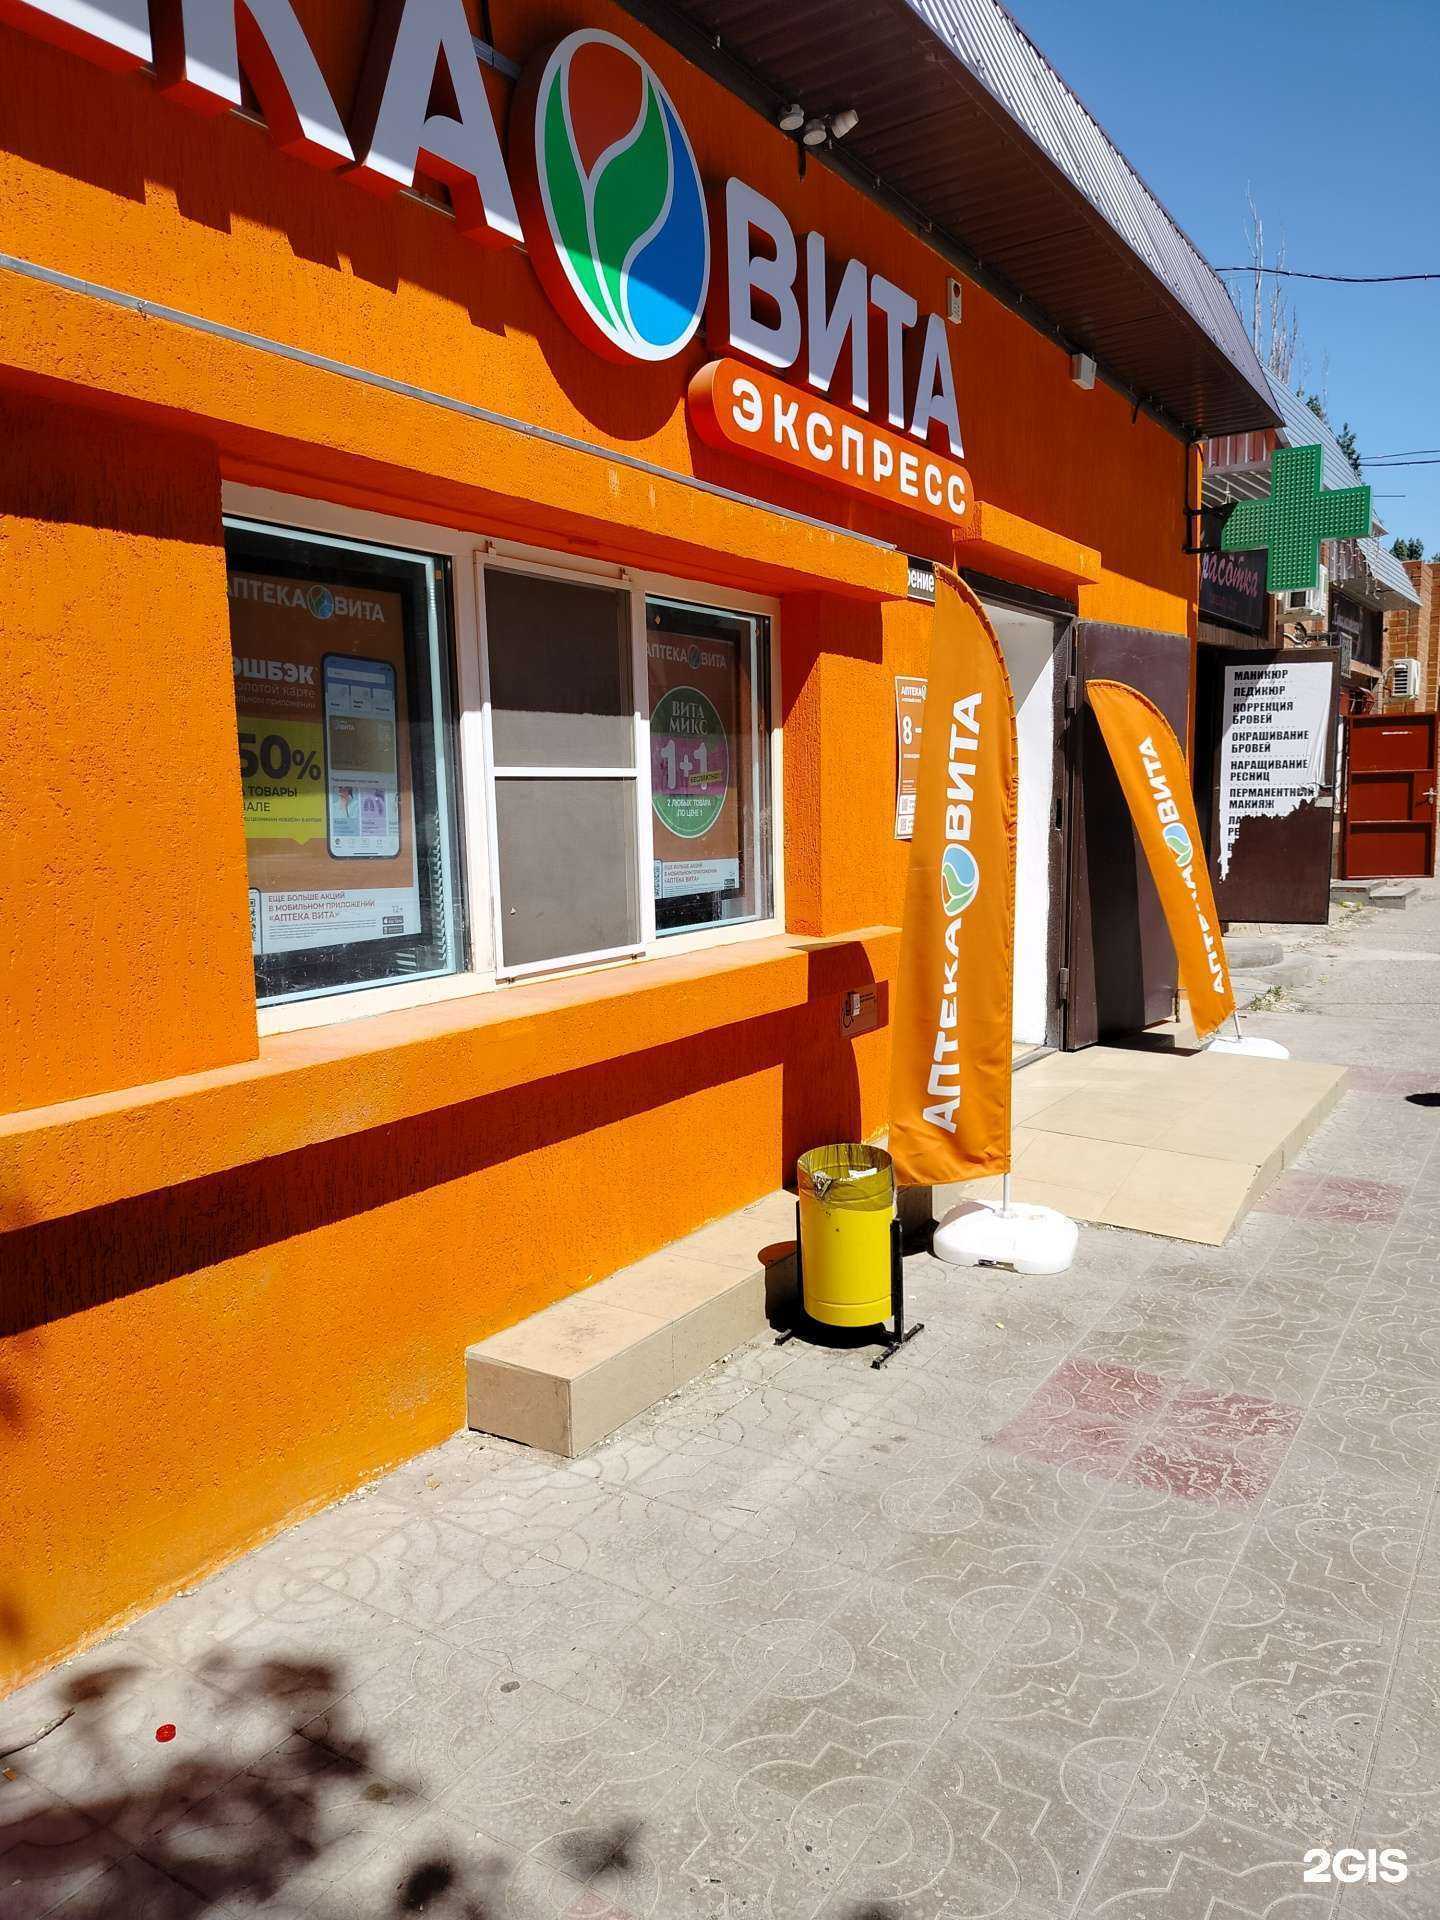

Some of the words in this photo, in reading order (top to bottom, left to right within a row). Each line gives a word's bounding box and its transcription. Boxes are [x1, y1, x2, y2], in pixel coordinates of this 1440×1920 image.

[726, 176, 965, 460] ВИТА
[732, 378, 966, 515] ЭКСПРЕСС
[335, 596, 385, 622] ВИТА
[701, 652, 728, 669] ВИТА
[1234, 670, 1288, 681] МАНИКЮР
[1233, 686, 1286, 697] ПЕДИКЮР
[672, 701, 705, 719] ВИТА
[1232, 701, 1294, 713] КОРРЕКЦИЯ
[1232, 712, 1272, 724] БРОВЕЙ
[669, 718, 708, 736] МИКС
[1232, 730, 1310, 741] ОКРАШИВАНИЕ
[1231, 741, 1271, 754] БРОВЕЙ
[945, 691, 983, 841] ВИТА
[1230, 759, 1308, 771] НАРАЩИВАНИЕ
[1138, 736, 1180, 824] ВИТА
[1230, 772, 1270, 782] РЕСНИЦ
[248, 786, 297, 797] ТОВАРЫ
[1229, 787, 1315, 797] ПЕРМАНЕНТНЫЙ
[1229, 799, 1275, 809] МАКИЯЖ
[287, 893, 319, 902] БОЛЬШЕ
[320, 891, 346, 900] АКЦИЙ
[268, 904, 274, 912] В
[275, 902, 325, 912] МОБИЛЬНОМ
[326, 899, 375, 909] ПРИЛОЖЕНИИ
[922, 916, 962, 1134] АПТЕКА
